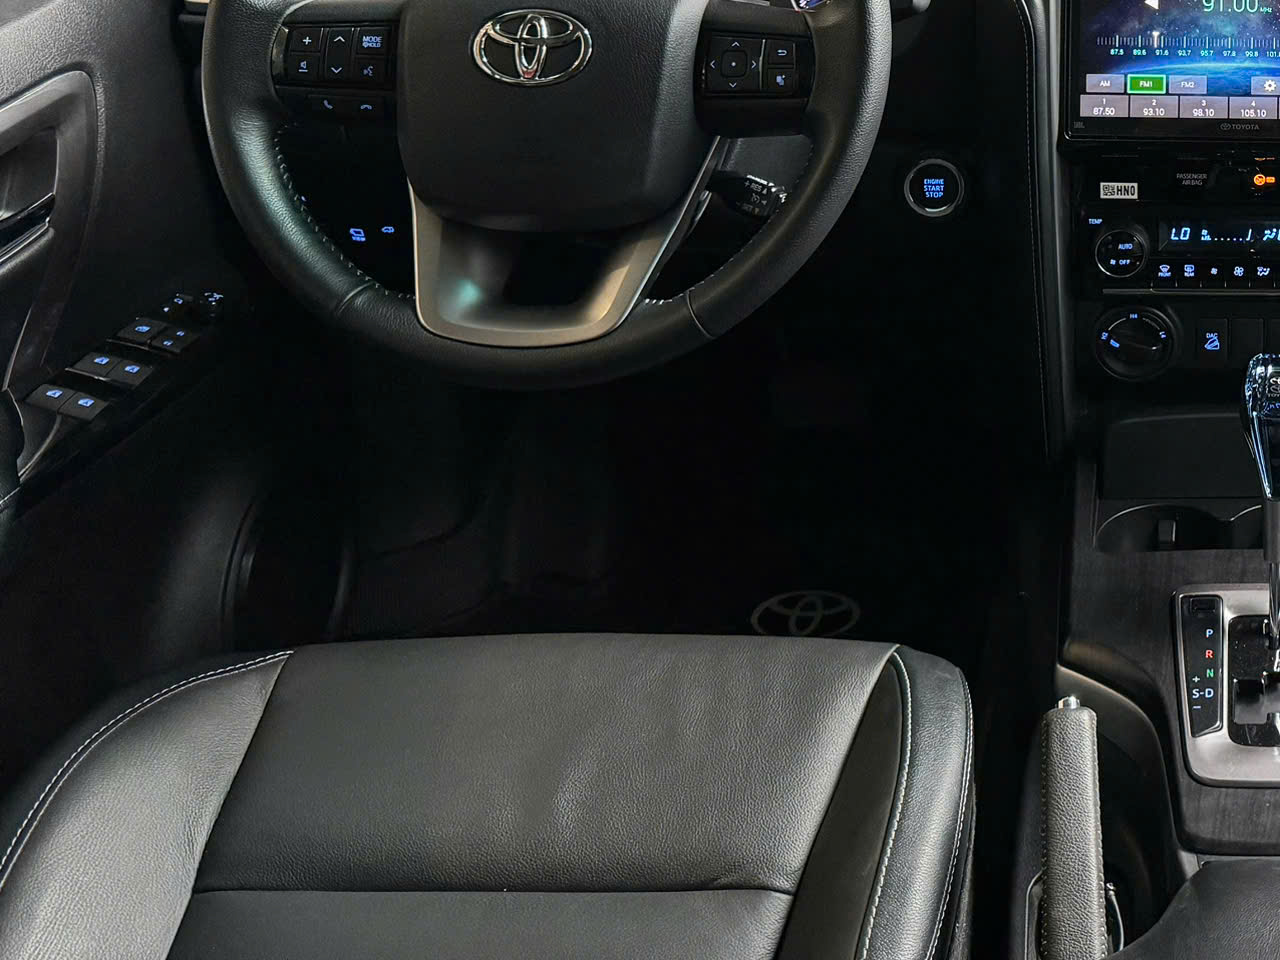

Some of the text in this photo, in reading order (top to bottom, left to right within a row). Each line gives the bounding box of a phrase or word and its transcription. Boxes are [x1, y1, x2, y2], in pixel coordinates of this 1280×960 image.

[1100, 79, 1111, 87] AM
[1093, 107, 1115, 116] 87.50
[1143, 108, 1165, 116] 93.10
[1192, 108, 1215, 117] 98.10
[1240, 109, 1267, 118] 105.10
[1171, 227, 1190, 240] LO
[1206, 629, 1213, 638] P
[1205, 649, 1213, 658] R
[1206, 669, 1214, 678] N
